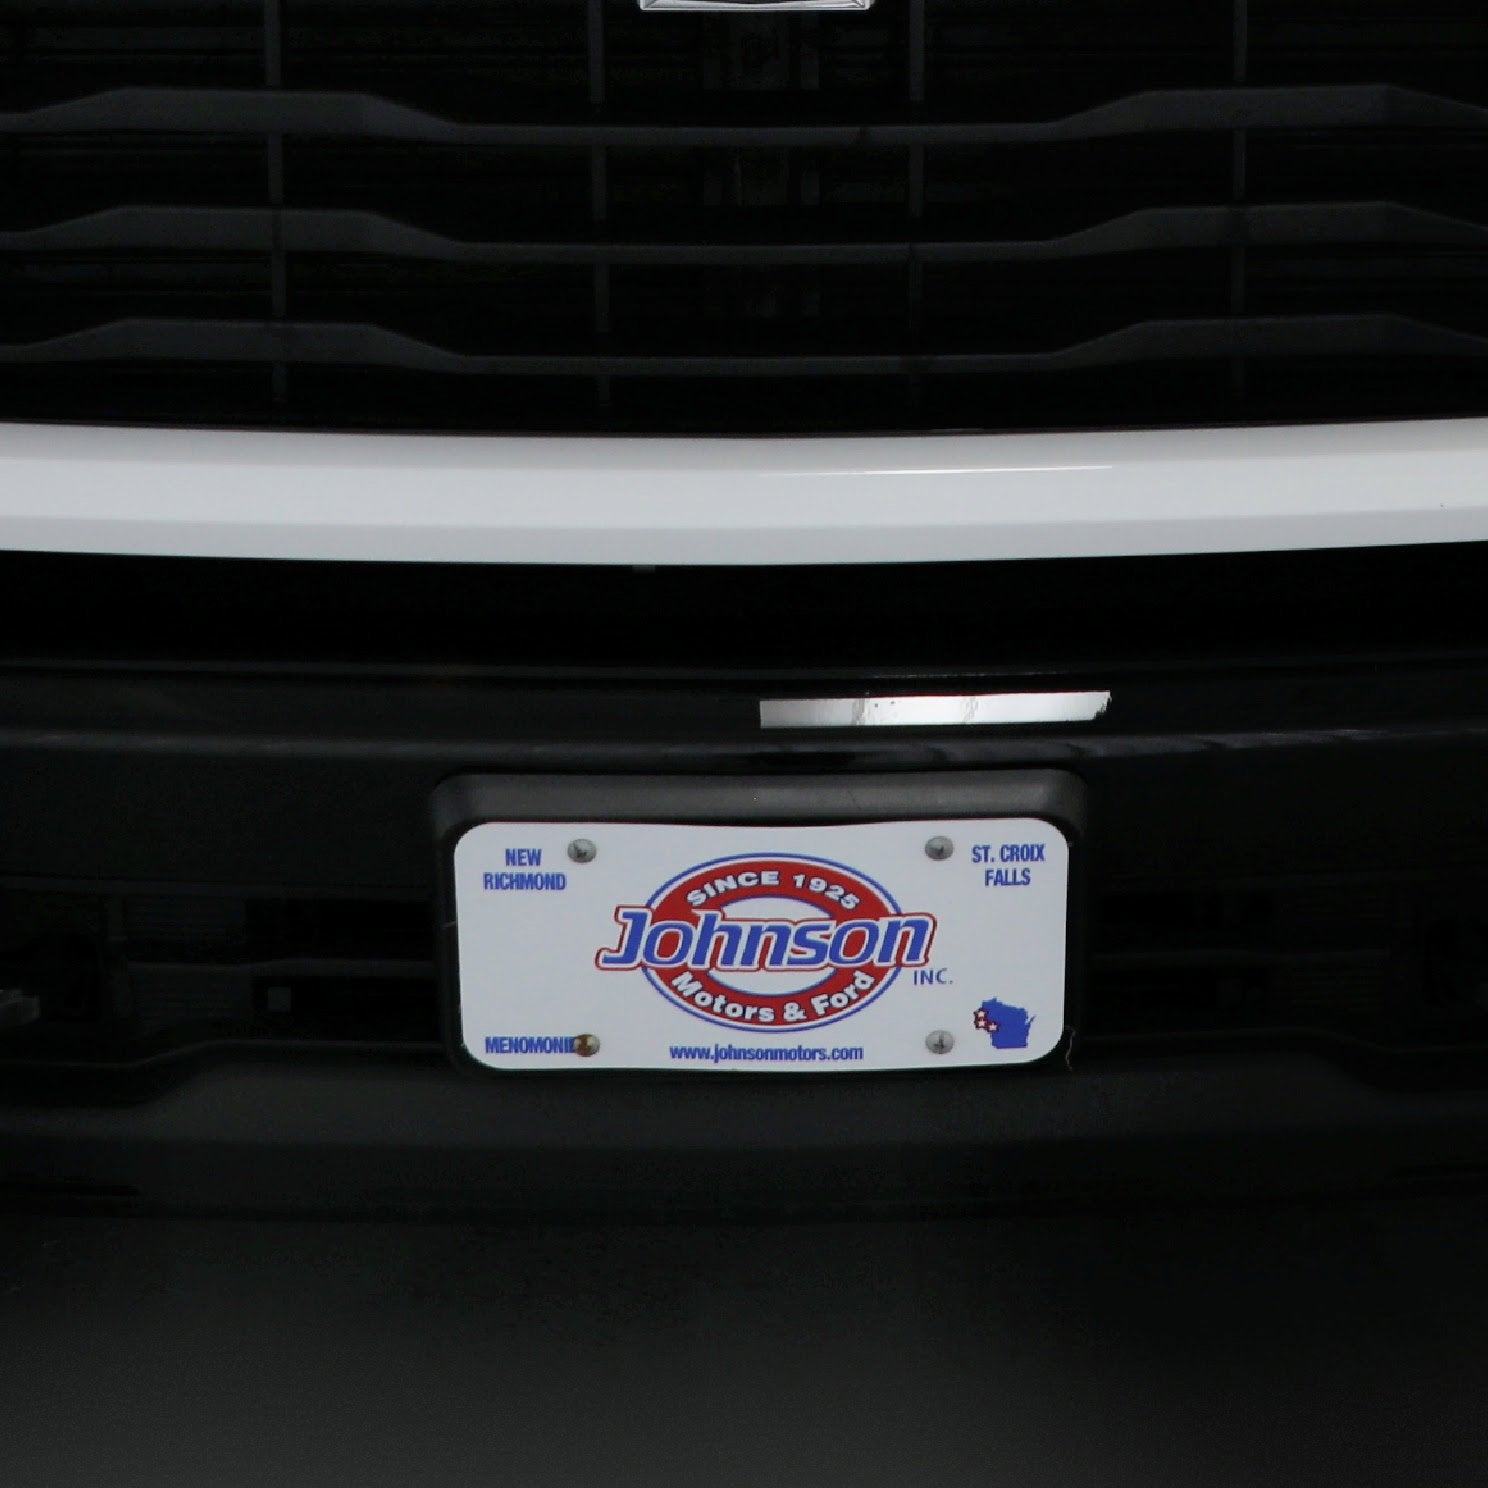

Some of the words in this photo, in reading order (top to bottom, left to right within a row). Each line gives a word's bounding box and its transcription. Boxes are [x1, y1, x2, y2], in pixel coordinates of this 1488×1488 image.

[505, 848, 542, 867] NEW
[972, 845, 995, 863] ST.
[1000, 843, 1045, 862] CROIX
[484, 872, 566, 891] RICHMOND
[984, 867, 1031, 886] FALLS
[687, 871, 779, 907] SINCE
[792, 873, 861, 911] 1925
[596, 906, 938, 972] Johnson
[913, 968, 953, 985] INC.
[671, 970, 776, 1023] Motors
[783, 1002, 807, 1023] &
[811, 969, 875, 1018] Ford
[669, 1043, 864, 1063] www.johnsonmotors.com
